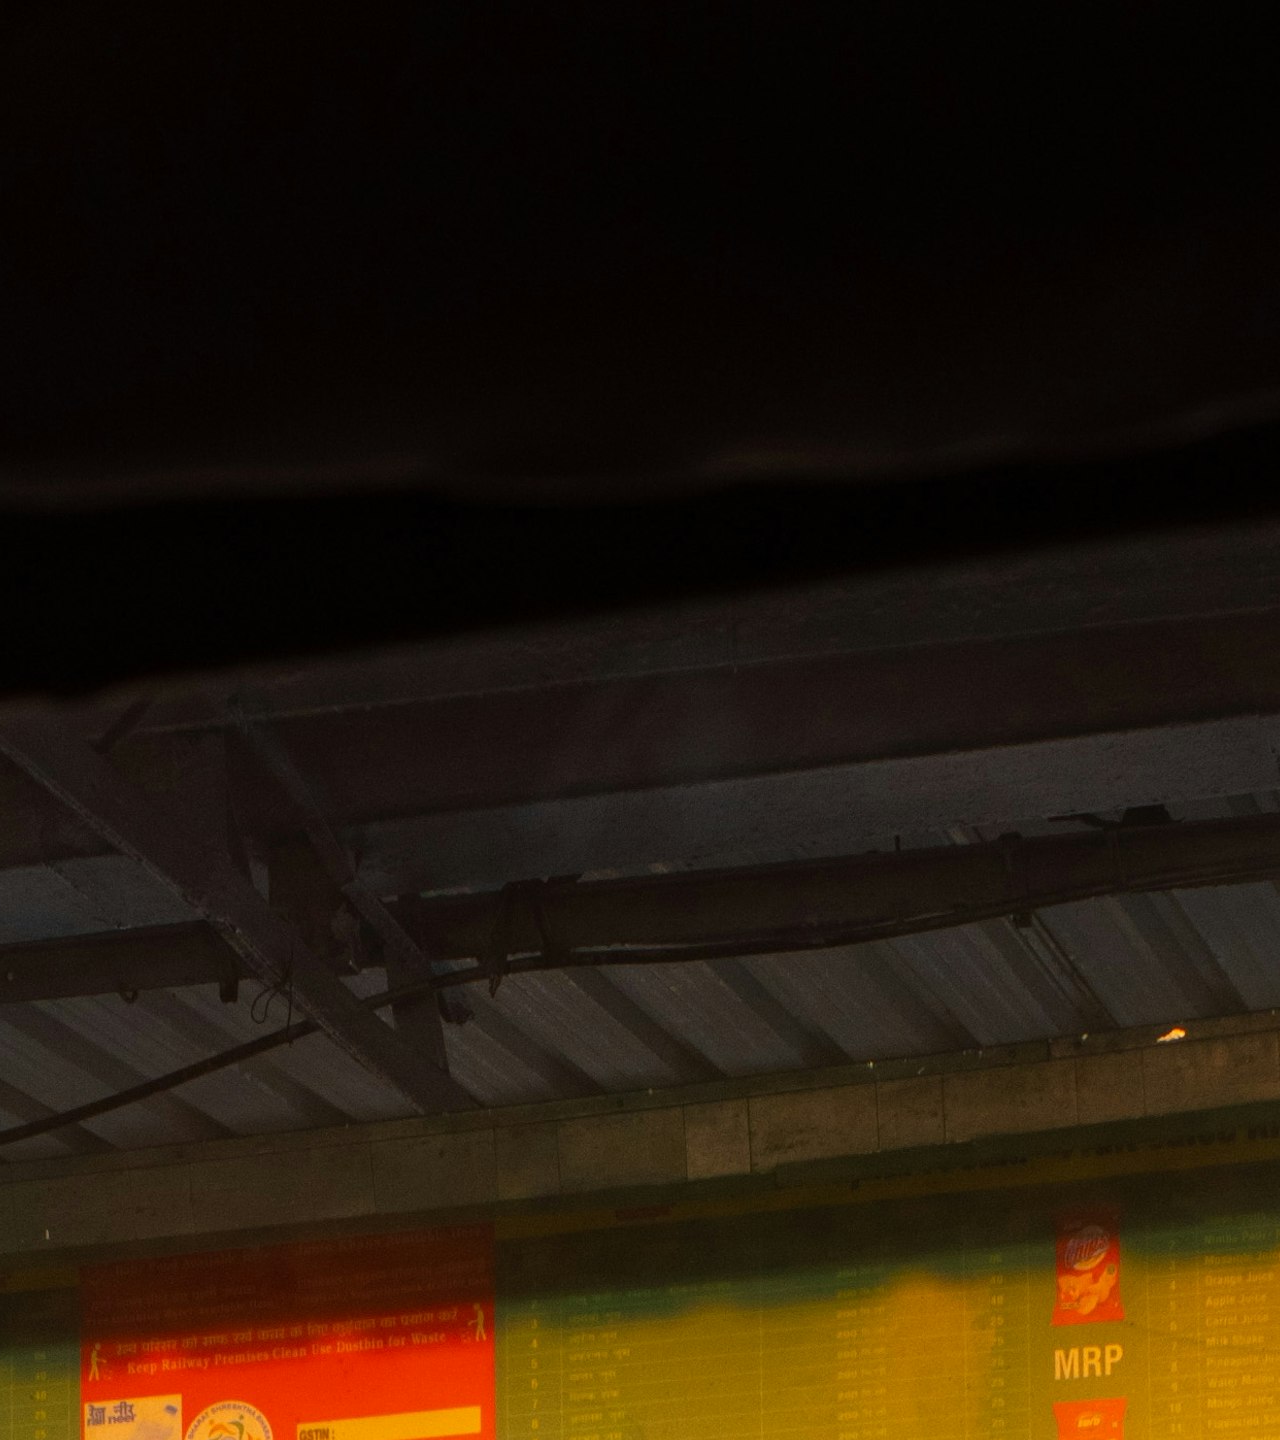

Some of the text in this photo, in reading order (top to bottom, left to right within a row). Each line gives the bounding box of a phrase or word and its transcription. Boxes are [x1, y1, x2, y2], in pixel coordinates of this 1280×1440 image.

[126, 1330, 447, 1375] Keep Railway Premises Clean Use Dustbin for Waste
[1054, 1344, 1124, 1381] MRP
